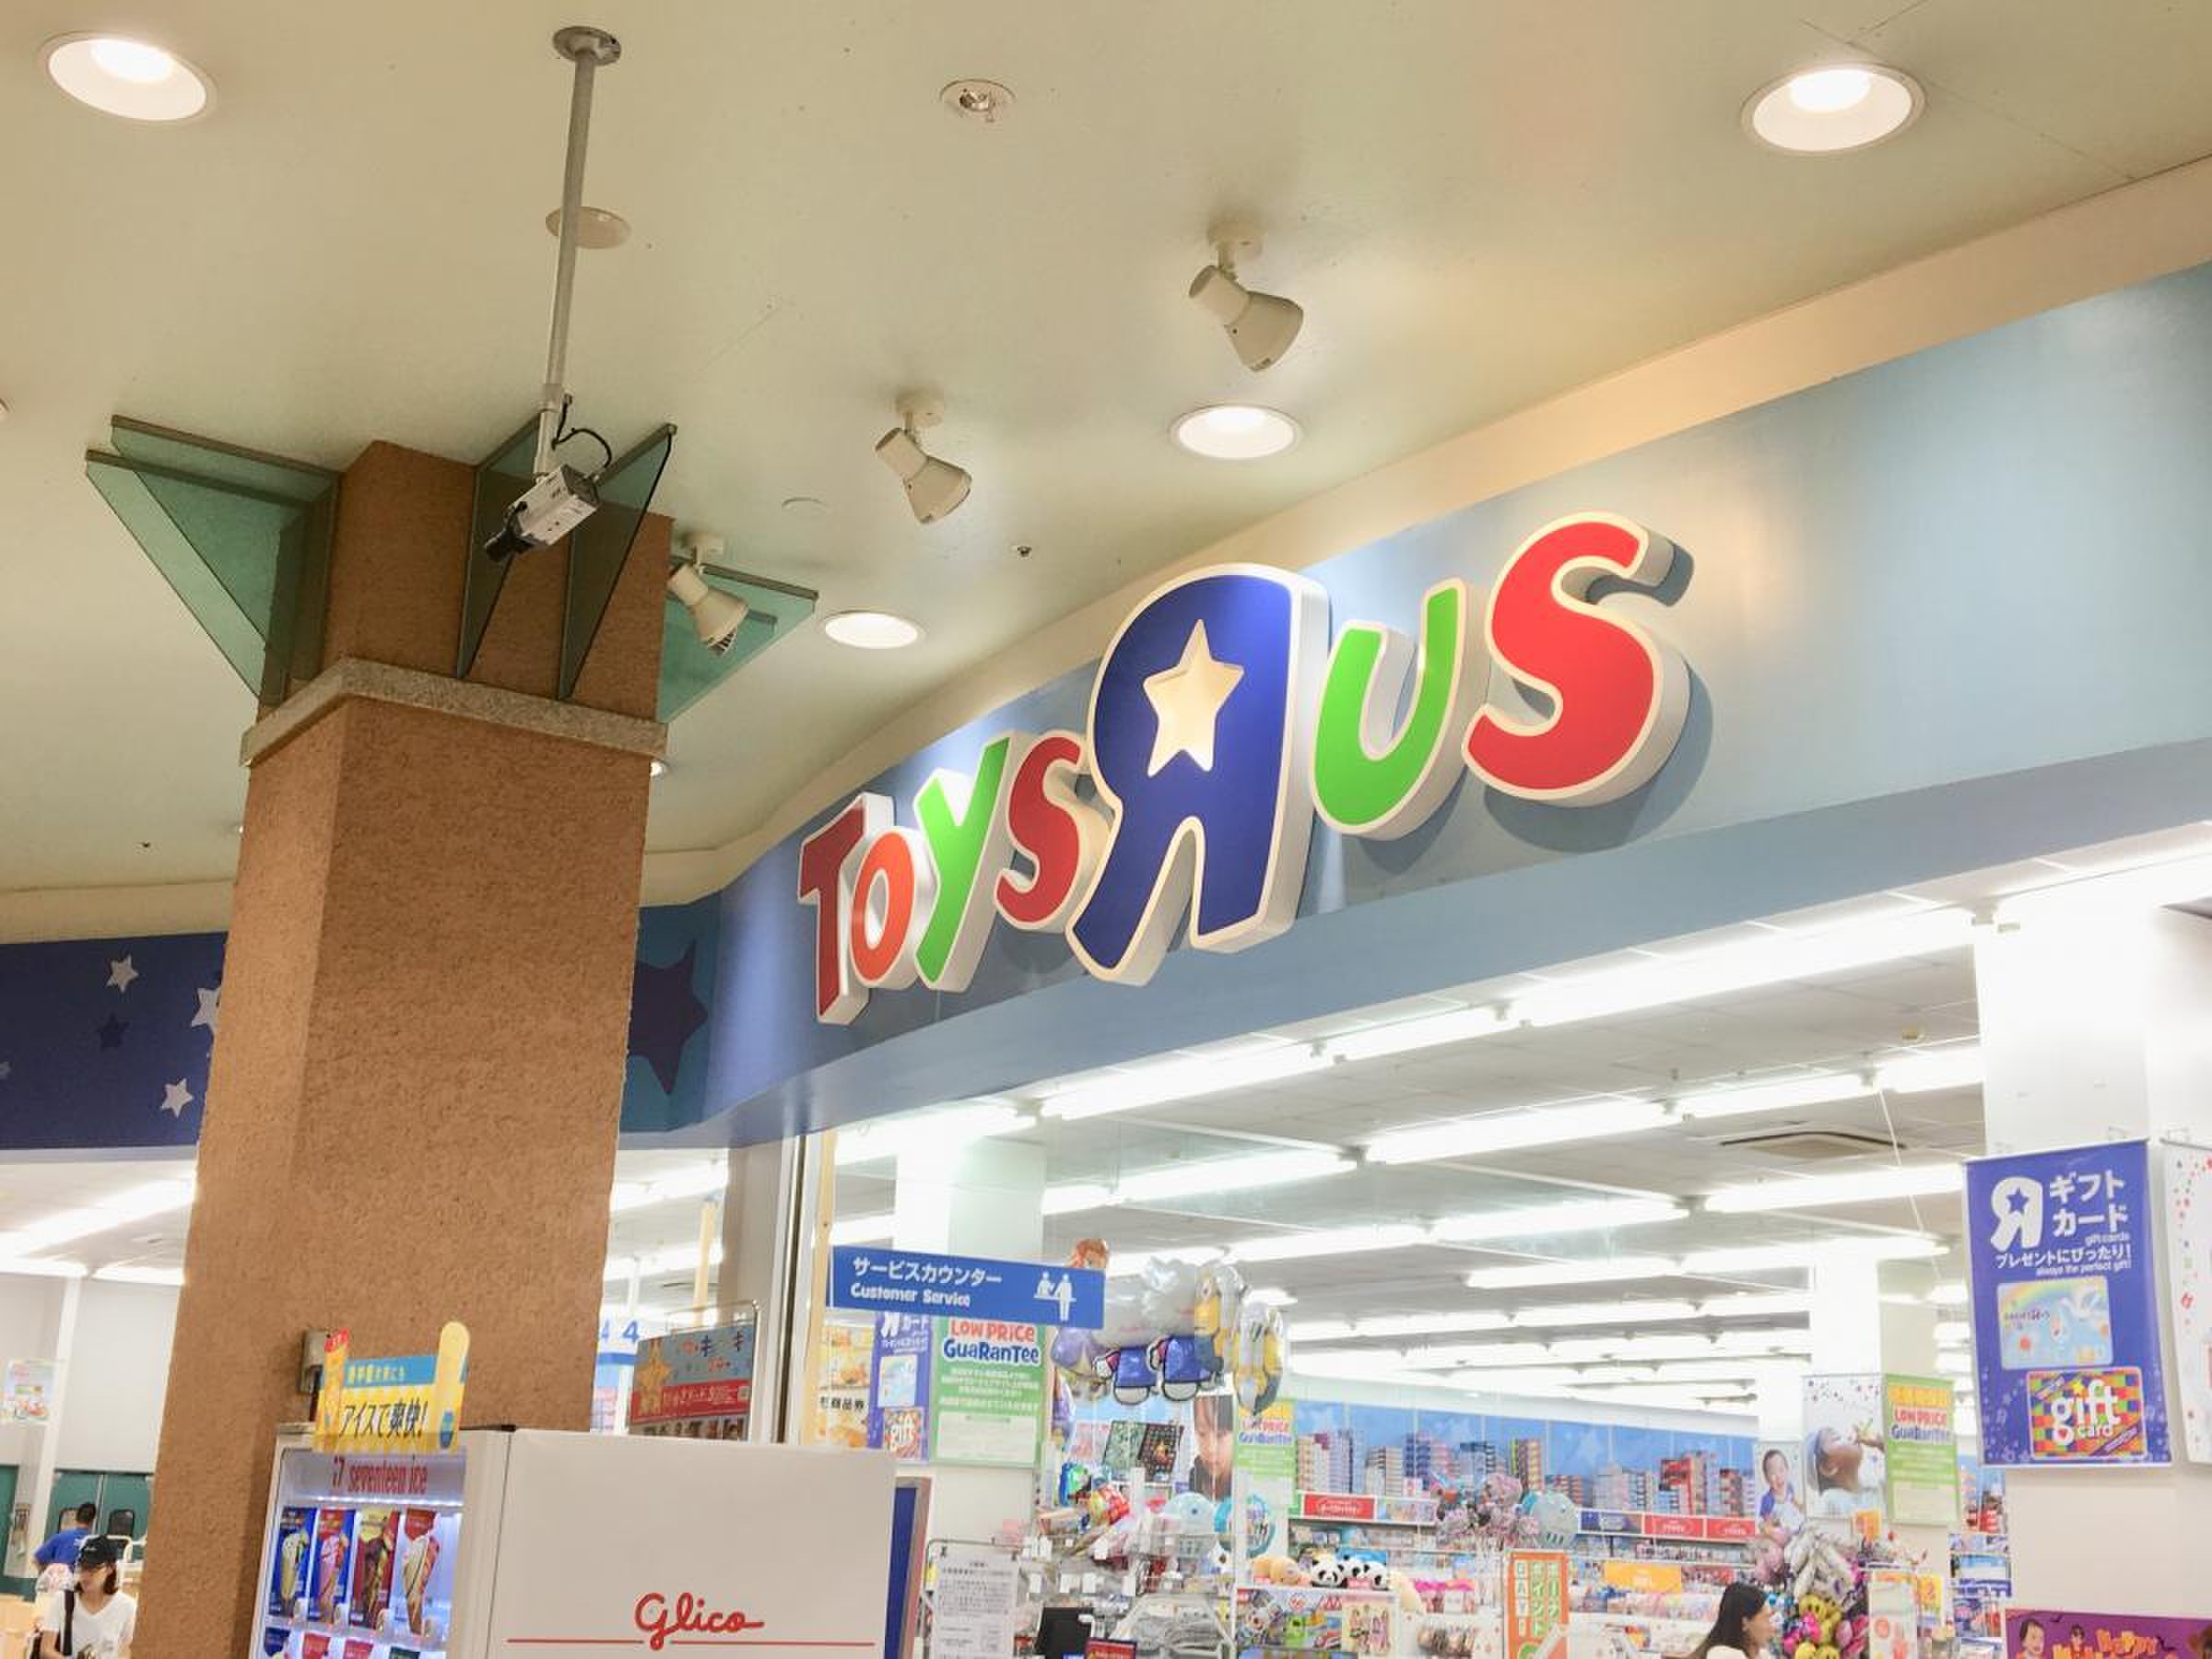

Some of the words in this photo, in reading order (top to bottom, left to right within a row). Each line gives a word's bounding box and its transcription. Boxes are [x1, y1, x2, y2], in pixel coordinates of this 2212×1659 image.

[2049, 1170, 2125, 1204] ギフト
[2053, 1204, 2128, 1237] カード
[853, 1256, 1003, 1286] サービスカウンター
[851, 1282, 917, 1301] Customer
[923, 1289, 971, 1307] Service
[621, 1321, 641, 1343] 4
[950, 1319, 983, 1336] LOW
[2051, 1380, 2122, 1446] gift
[634, 1592, 765, 1651] Glico
